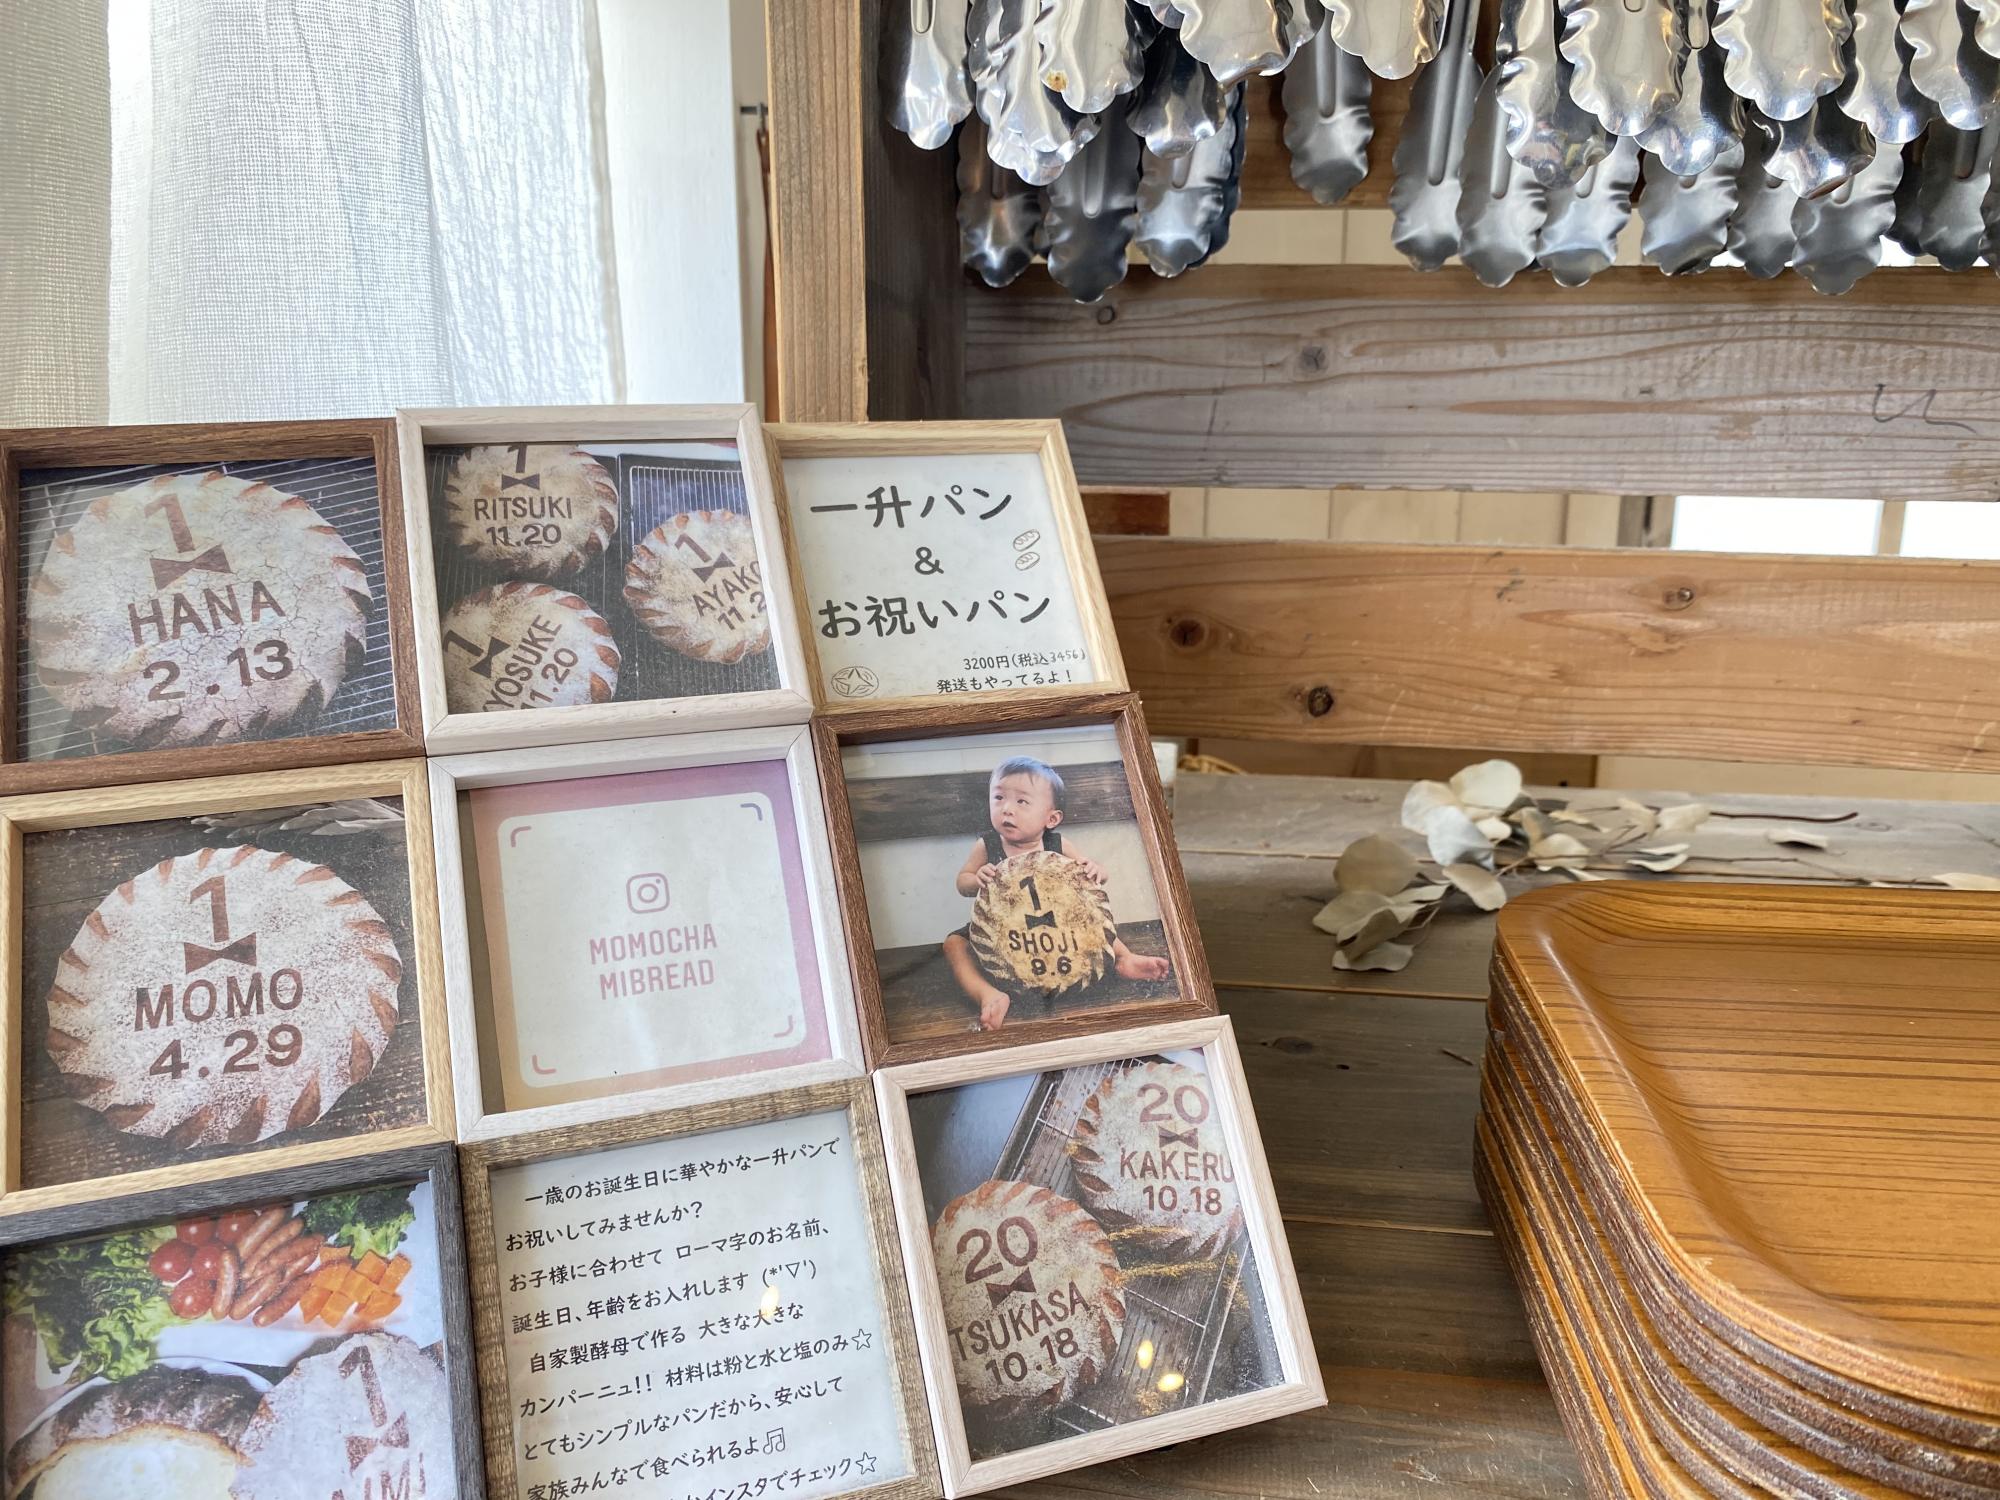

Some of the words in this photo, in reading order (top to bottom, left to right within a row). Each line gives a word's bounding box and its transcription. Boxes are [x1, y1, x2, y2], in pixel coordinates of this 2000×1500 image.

[507, 442, 527, 473] 1
[144, 493, 196, 553] 1
[474, 496, 572, 520] RITSUKI
[810, 484, 1012, 528] 一升パン
[486, 523, 561, 547] 11.20
[675, 533, 712, 563] 1
[914, 546, 944, 575] &
[128, 580, 286, 647] HANA
[818, 589, 1050, 638] お祝いパン
[143, 640, 293, 702] 2.13
[442, 630, 484, 657] 1
[482, 614, 562, 711] YOSUKE
[190, 875, 230, 943] 1
[1019, 875, 1041, 911] 1
[590, 923, 717, 965] MOMOCHA
[134, 968, 303, 1032] MOMO
[599, 959, 715, 1000] MIBREAD
[149, 1023, 303, 1080] 4.29
[1137, 1083, 1210, 1124] 20
[525, 1138, 840, 1206] 一歳のお誕生日に華やかな一升パンで
[1120, 1147, 1234, 1183] KAKERU
[1142, 1185, 1222, 1216] 10.18
[509, 1249, 663, 1292] お子様に合わせて
[676, 1218, 830, 1259] ローマ字のお名前、
[956, 1216, 1038, 1285] 20
[512, 1272, 749, 1334] 誕生日、年齢をお入れします
[949, 1281, 1092, 1361] TSUKASA
[530, 1326, 686, 1374] 自家製酵母で作る
[698, 1302, 804, 1339] 大きな大きな
[985, 1328, 1079, 1386] 10.18
[339, 1344, 387, 1427] 1
[524, 1376, 844, 1461] とてもシンプルなパンだから、安心して
